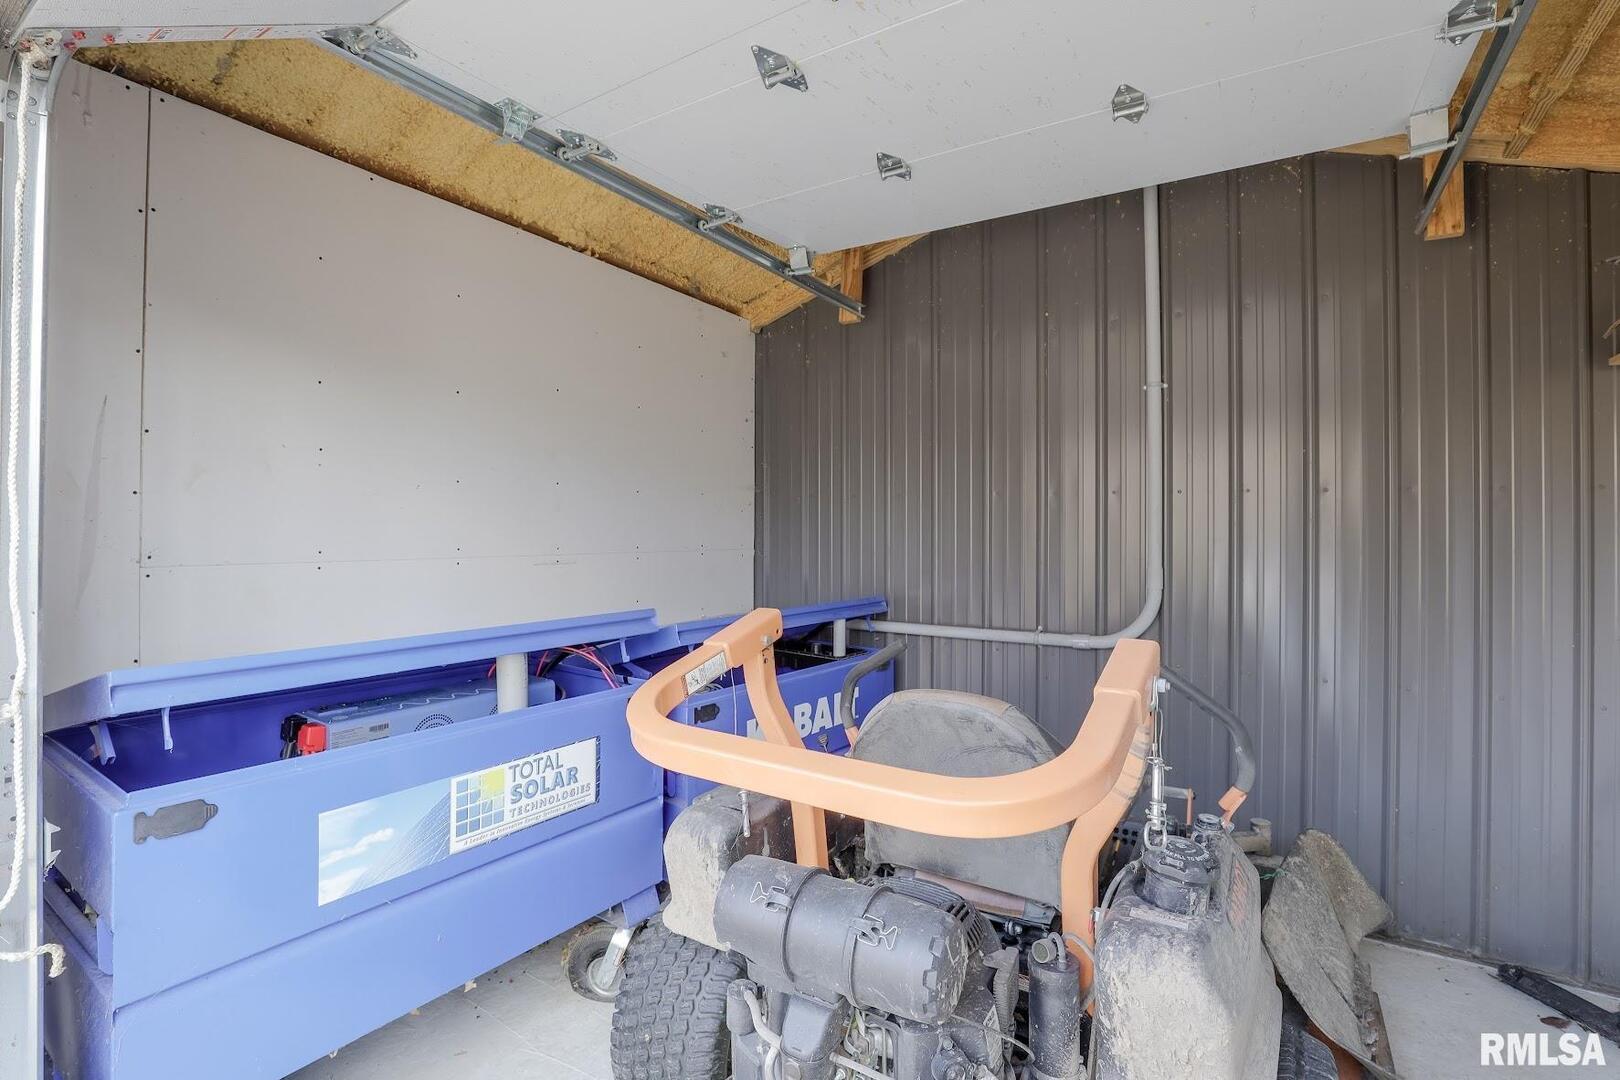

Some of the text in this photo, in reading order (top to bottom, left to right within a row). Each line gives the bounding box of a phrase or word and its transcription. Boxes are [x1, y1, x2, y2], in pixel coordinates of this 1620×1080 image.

[746, 686, 860, 740] BAL
[508, 752, 563, 783] TOTAL
[510, 766, 579, 804] SOLAR
[508, 783, 591, 818] TECHNOLOGIES
